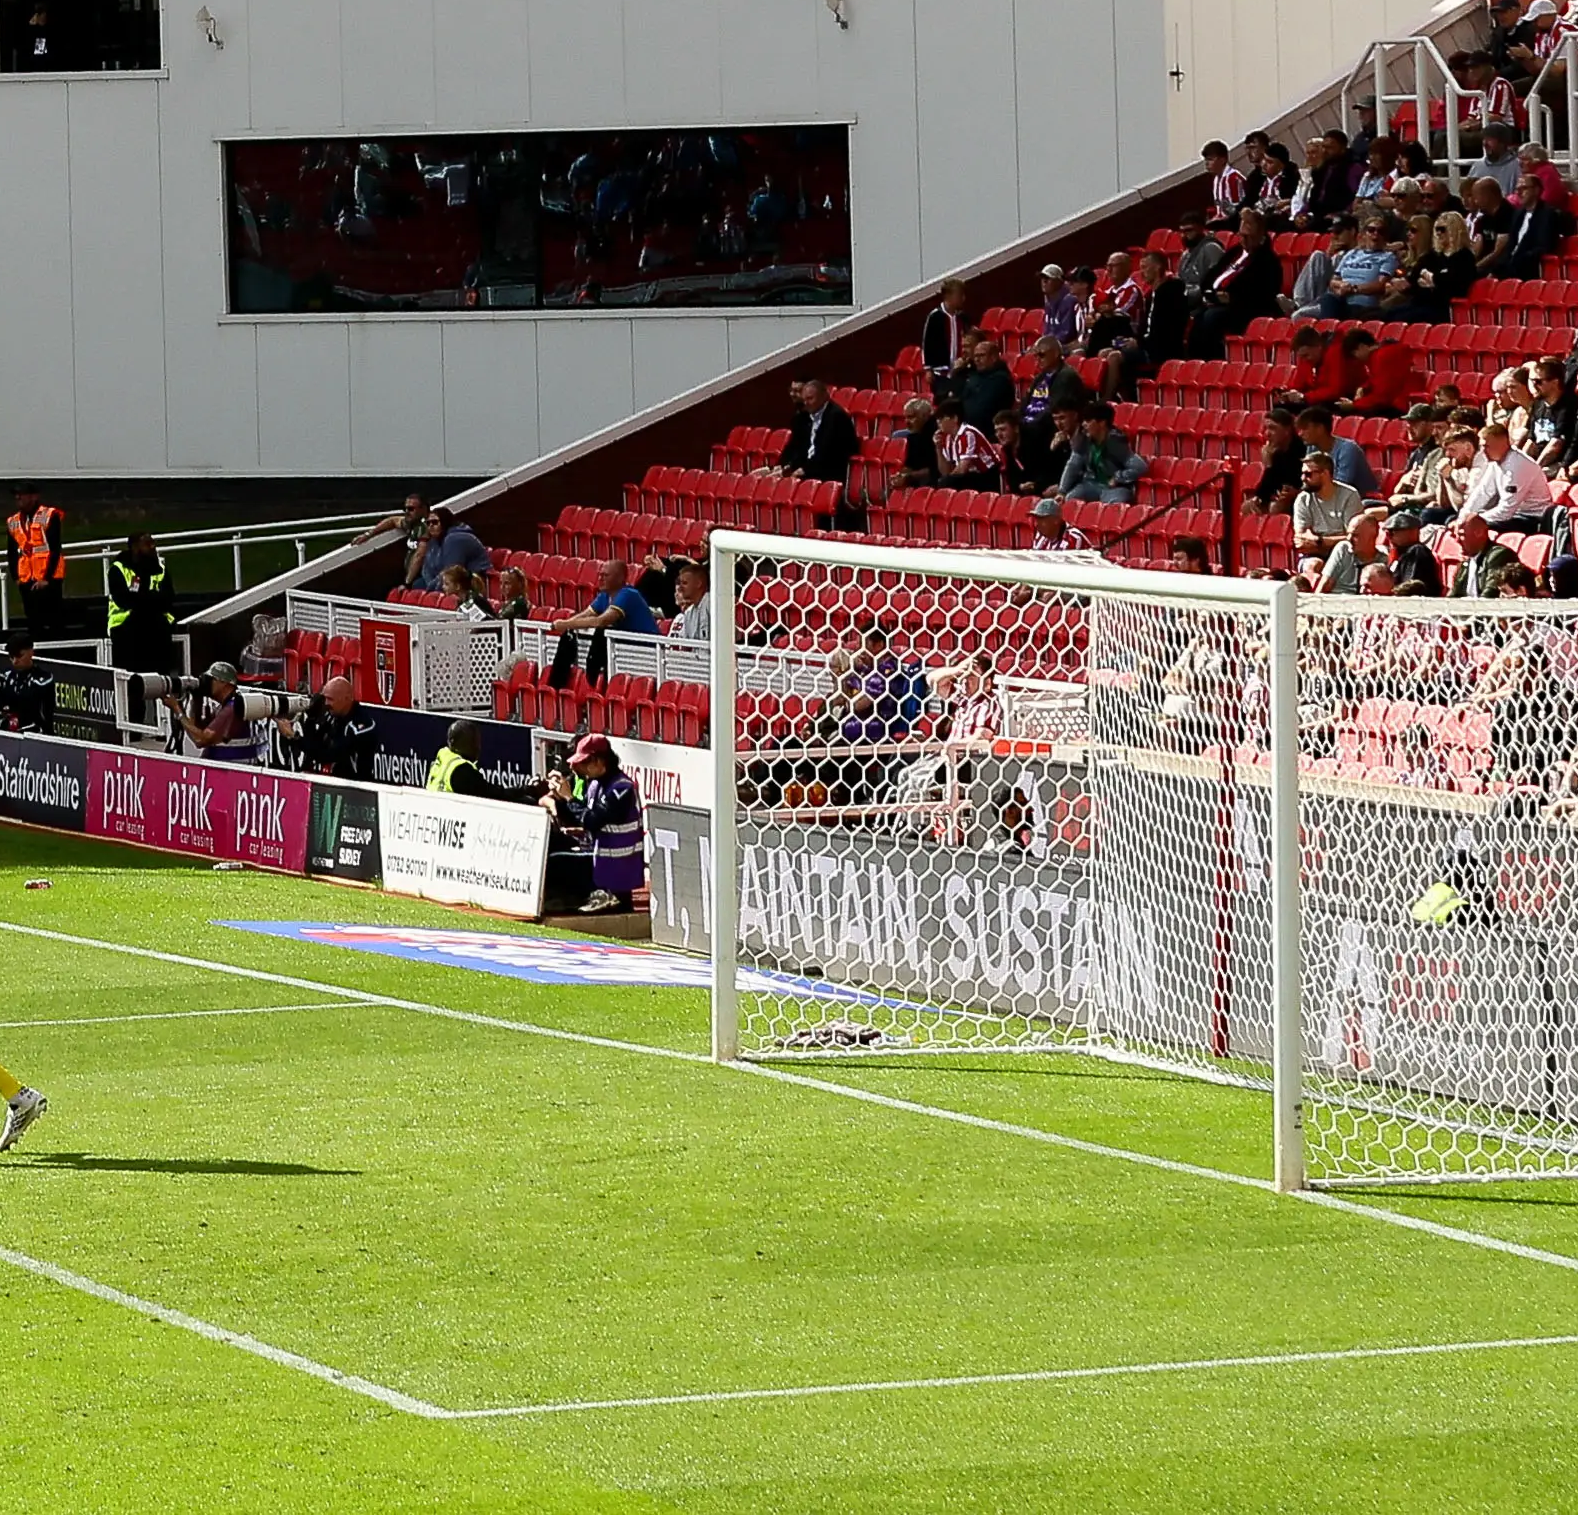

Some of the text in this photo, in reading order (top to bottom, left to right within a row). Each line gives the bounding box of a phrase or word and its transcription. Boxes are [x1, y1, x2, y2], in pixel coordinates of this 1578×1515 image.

[373, 744, 427, 786] niversity
[643, 767, 682, 805] UNITA
[103, 756, 145, 830] pink
[168, 766, 213, 841] pink
[236, 775, 286, 852] pink
[191, 830, 214, 854] leasing
[260, 841, 284, 865] leasing
